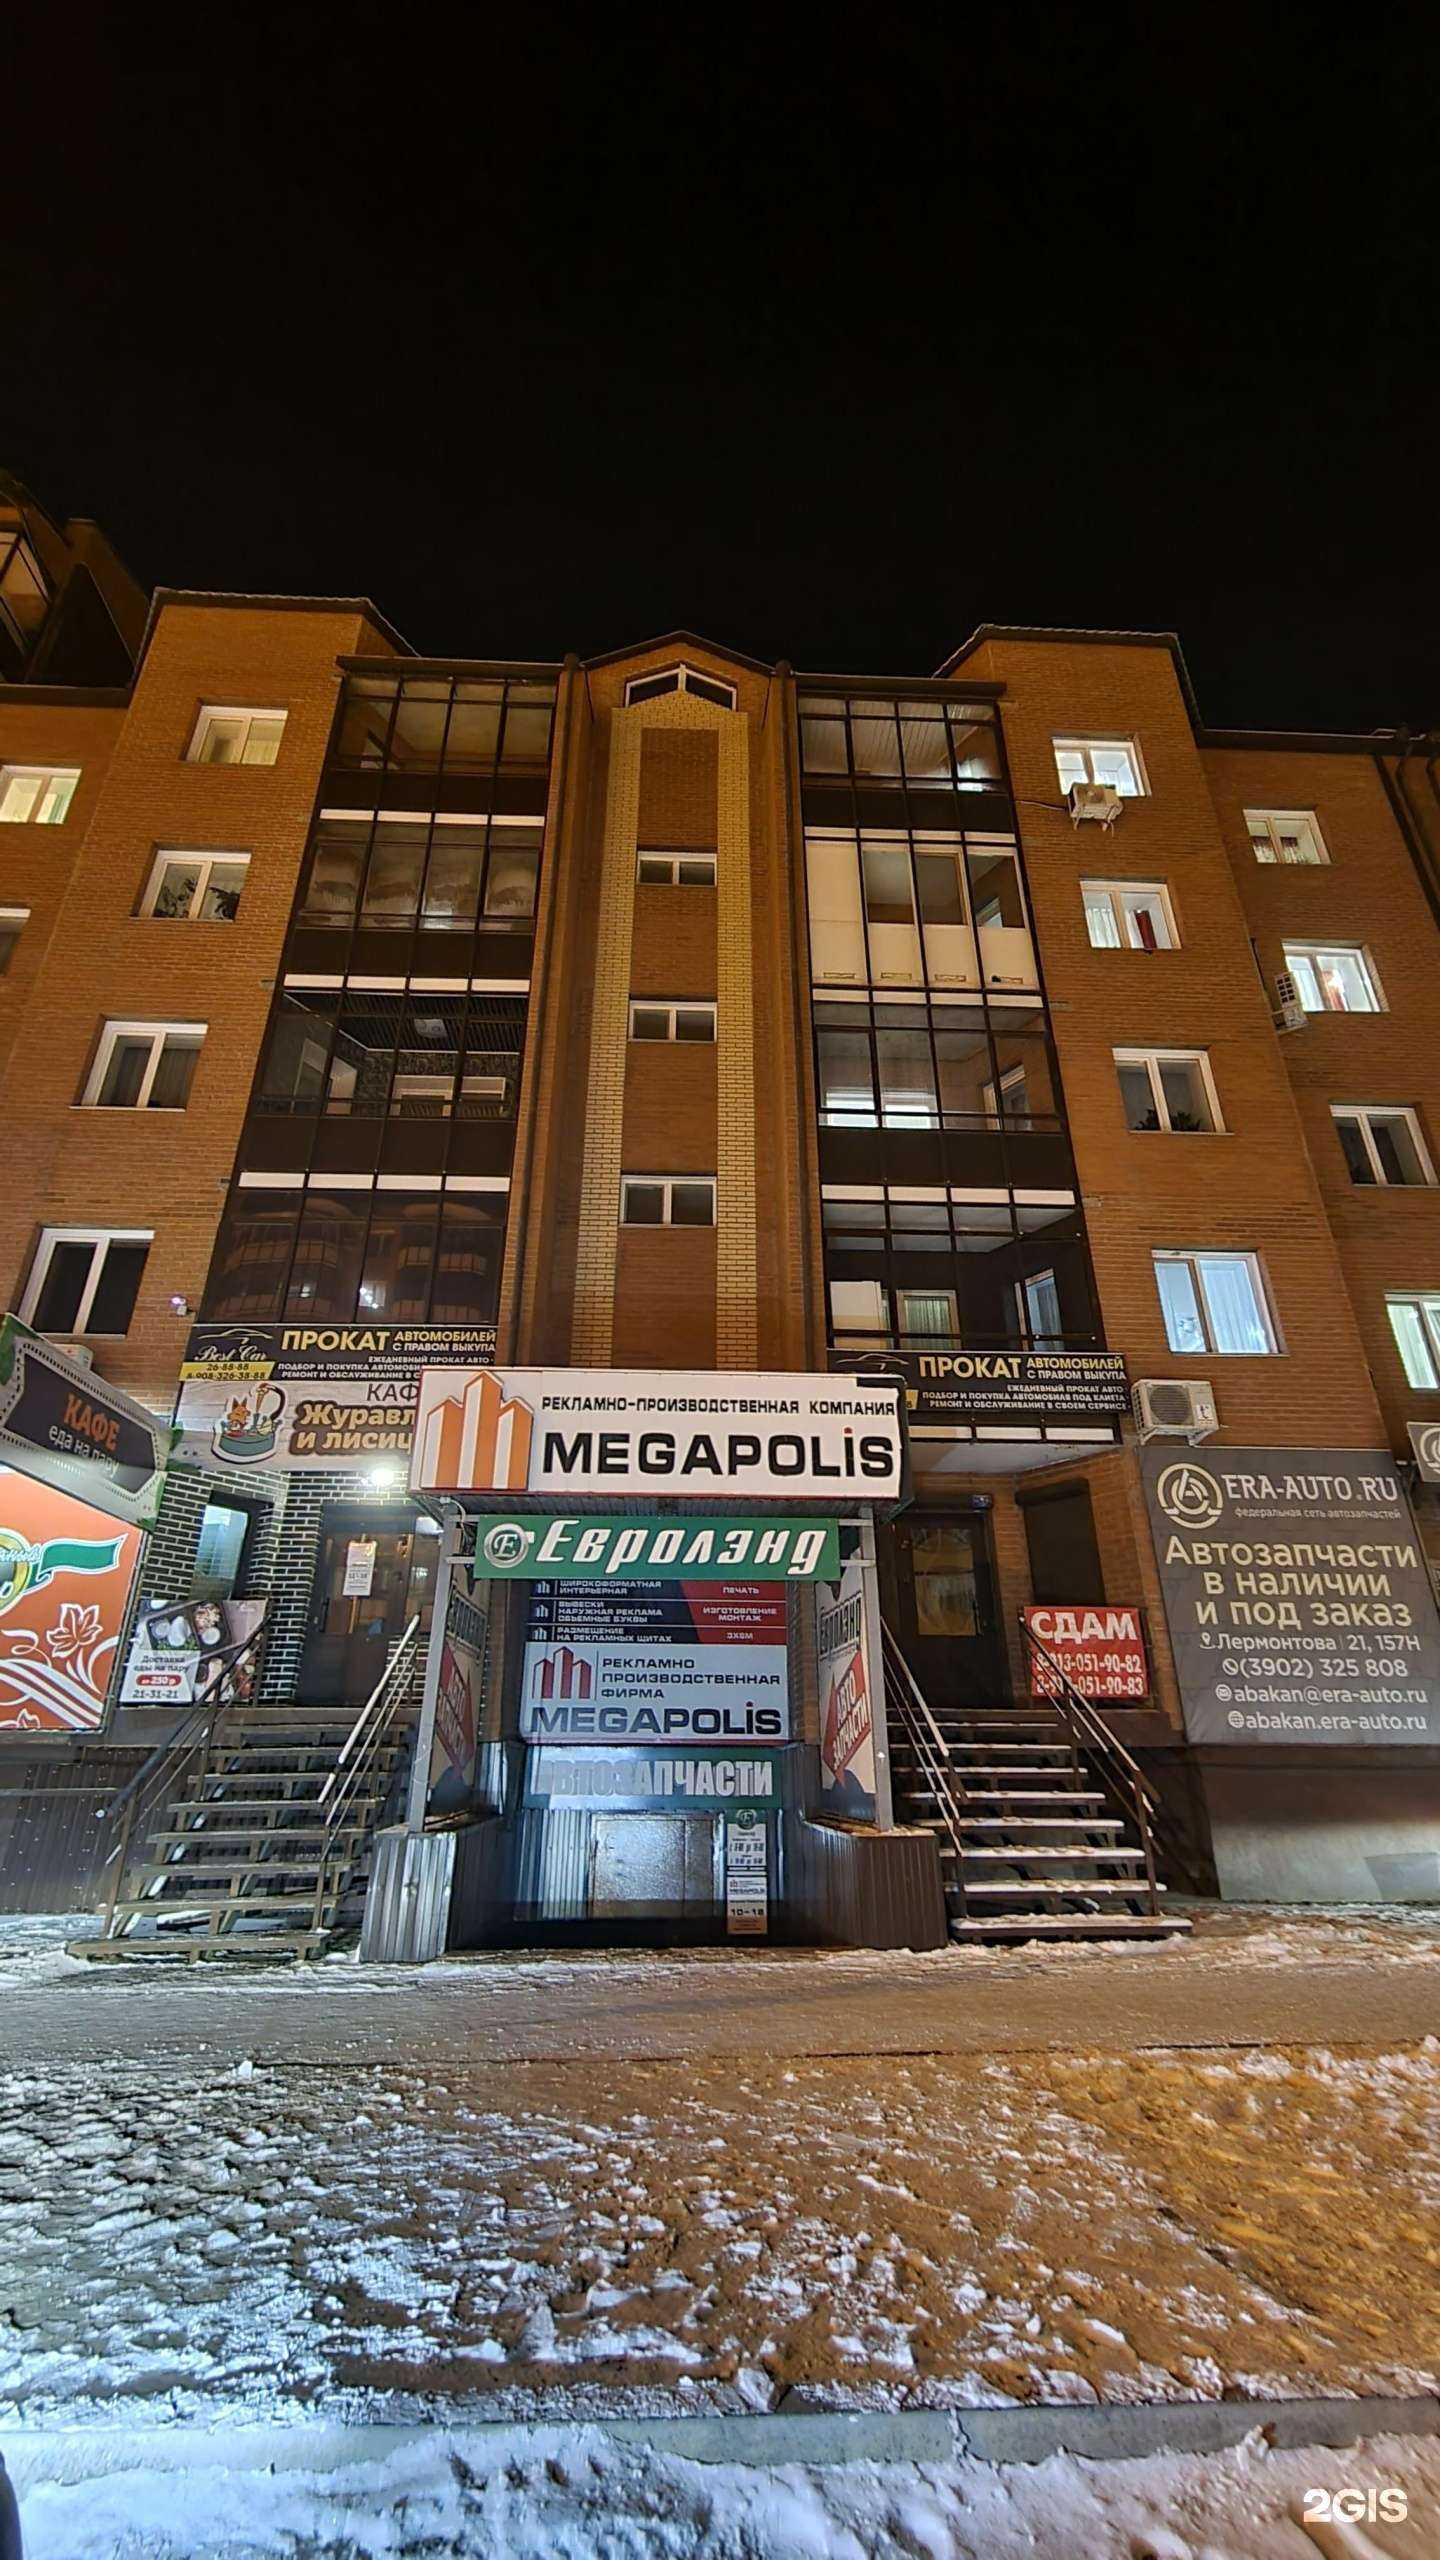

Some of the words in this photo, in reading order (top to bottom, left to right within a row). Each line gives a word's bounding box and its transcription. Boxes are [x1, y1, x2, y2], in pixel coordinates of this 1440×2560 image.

[281, 1330, 390, 1351] ПРОКАТ
[394, 1330, 496, 1342] АВТОМОБИЛЕЙ
[194, 1346, 237, 1361] Best
[239, 1344, 267, 1361] Car
[393, 1343, 400, 1351] С
[404, 1343, 450, 1351] ПРАВОМ
[453, 1343, 496, 1352] ВЫКУПА
[368, 1355, 428, 1363] ЕЖЕДНЕВНЫЙ
[431, 1356, 465, 1364] ПРОКАТ
[467, 1356, 489, 1364] АВТО
[1026, 1356, 1124, 1370] АВТОМОБИЛЕЙ
[278, 1363, 315, 1371] ПОДБОР
[317, 1363, 325, 1371] И
[326, 1363, 368, 1371] ПОКУПКА
[918, 1356, 1022, 1378] ПРОКАТ
[281, 1371, 318, 1379] РЕМОНТ
[320, 1371, 326, 1379] И
[328, 1371, 403, 1379] ОБСЛУЖИВАНИЕ
[405, 1371, 411, 1379] В
[1026, 1370, 1037, 1379] С
[1038, 1370, 1082, 1380] ПРАВОМ
[1084, 1371, 1127, 1380] ВЫКУПА
[1007, 1384, 1065, 1392] ЕЖЕДНЕВНЫЙ
[1066, 1385, 1099, 1393] ПРОКАТ
[922, 1391, 958, 1399] ПОДБОР
[968, 1392, 1011, 1400] ПОКУПКА
[1012, 1393, 1070, 1401] АВТОМОБИЛЯ
[1072, 1393, 1092, 1401] ПОД
[541, 1396, 800, 1415] РЕКЛАМНО-ПРОИЗВОДСТВЕННАЯ
[809, 1400, 895, 1416] КОМПАНИЯ
[929, 1400, 962, 1408] РЕМОНТ
[973, 1401, 1045, 1409] ОБСЛУЖИВАНИЕ
[1088, 1402, 1127, 1410] СЕРВИСЕ
[63, 1392, 121, 1451] КАФЕ
[296, 1432, 317, 1449] и
[49, 1425, 72, 1450] еда
[74, 1439, 90, 1457] на
[91, 1450, 120, 1479] пару
[1221, 1474, 1399, 1501] ERA-AUTO.RU
[1235, 1507, 1301, 1519] федеральная
[1303, 1509, 1326, 1519] сеть
[1327, 1508, 1401, 1519] автозапчастей
[535, 1519, 827, 1576] Евролэнд
[1165, 1535, 1418, 1568] Автозапчасти
[560, 1580, 662, 1588] ШИРОКОФОРМАТНАЯ
[1204, 1572, 1224, 1595] в
[1236, 1573, 1392, 1597] наличии
[559, 1587, 628, 1595] ИНТЕРЬЕРНАЯ
[722, 1586, 760, 1595] ПЕЧАТЬ
[703, 1607, 777, 1615] ИЗГОТОВЛЕНИЕ
[1196, 1601, 1218, 1625] и
[1230, 1602, 1302, 1630] под
[1309, 1602, 1412, 1628] заказ
[558, 1615, 611, 1623] ОБЪЕМНЫЕ
[718, 1614, 762, 1622] МОНТАЖ
[557, 1627, 624, 1635] РАЗМЕЩЕНИЕ
[1031, 1612, 1138, 1644] СДАМ
[637, 1635, 672, 1643] ЩИТАХ
[1216, 1633, 1337, 1653] Лермонтова
[1375, 1635, 1421, 1651] 157Н
[602, 1658, 695, 1669] РЕКЛАМНО
[1239, 1658, 1314, 1679] (3902)
[1319, 1659, 1359, 1677] 325
[1365, 1659, 1408, 1677] 808
[601, 1673, 781, 1686] ПРОИЗВОДСТВЕННАЯ
[601, 1688, 665, 1699] ФИРМА
[1234, 1684, 1428, 1706] abakan@era-auto.ru
[1245, 1710, 1427, 1730] abakan.era-auto.ru
[535, 1759, 774, 1797] АВТОЗАПЧАСТИ
